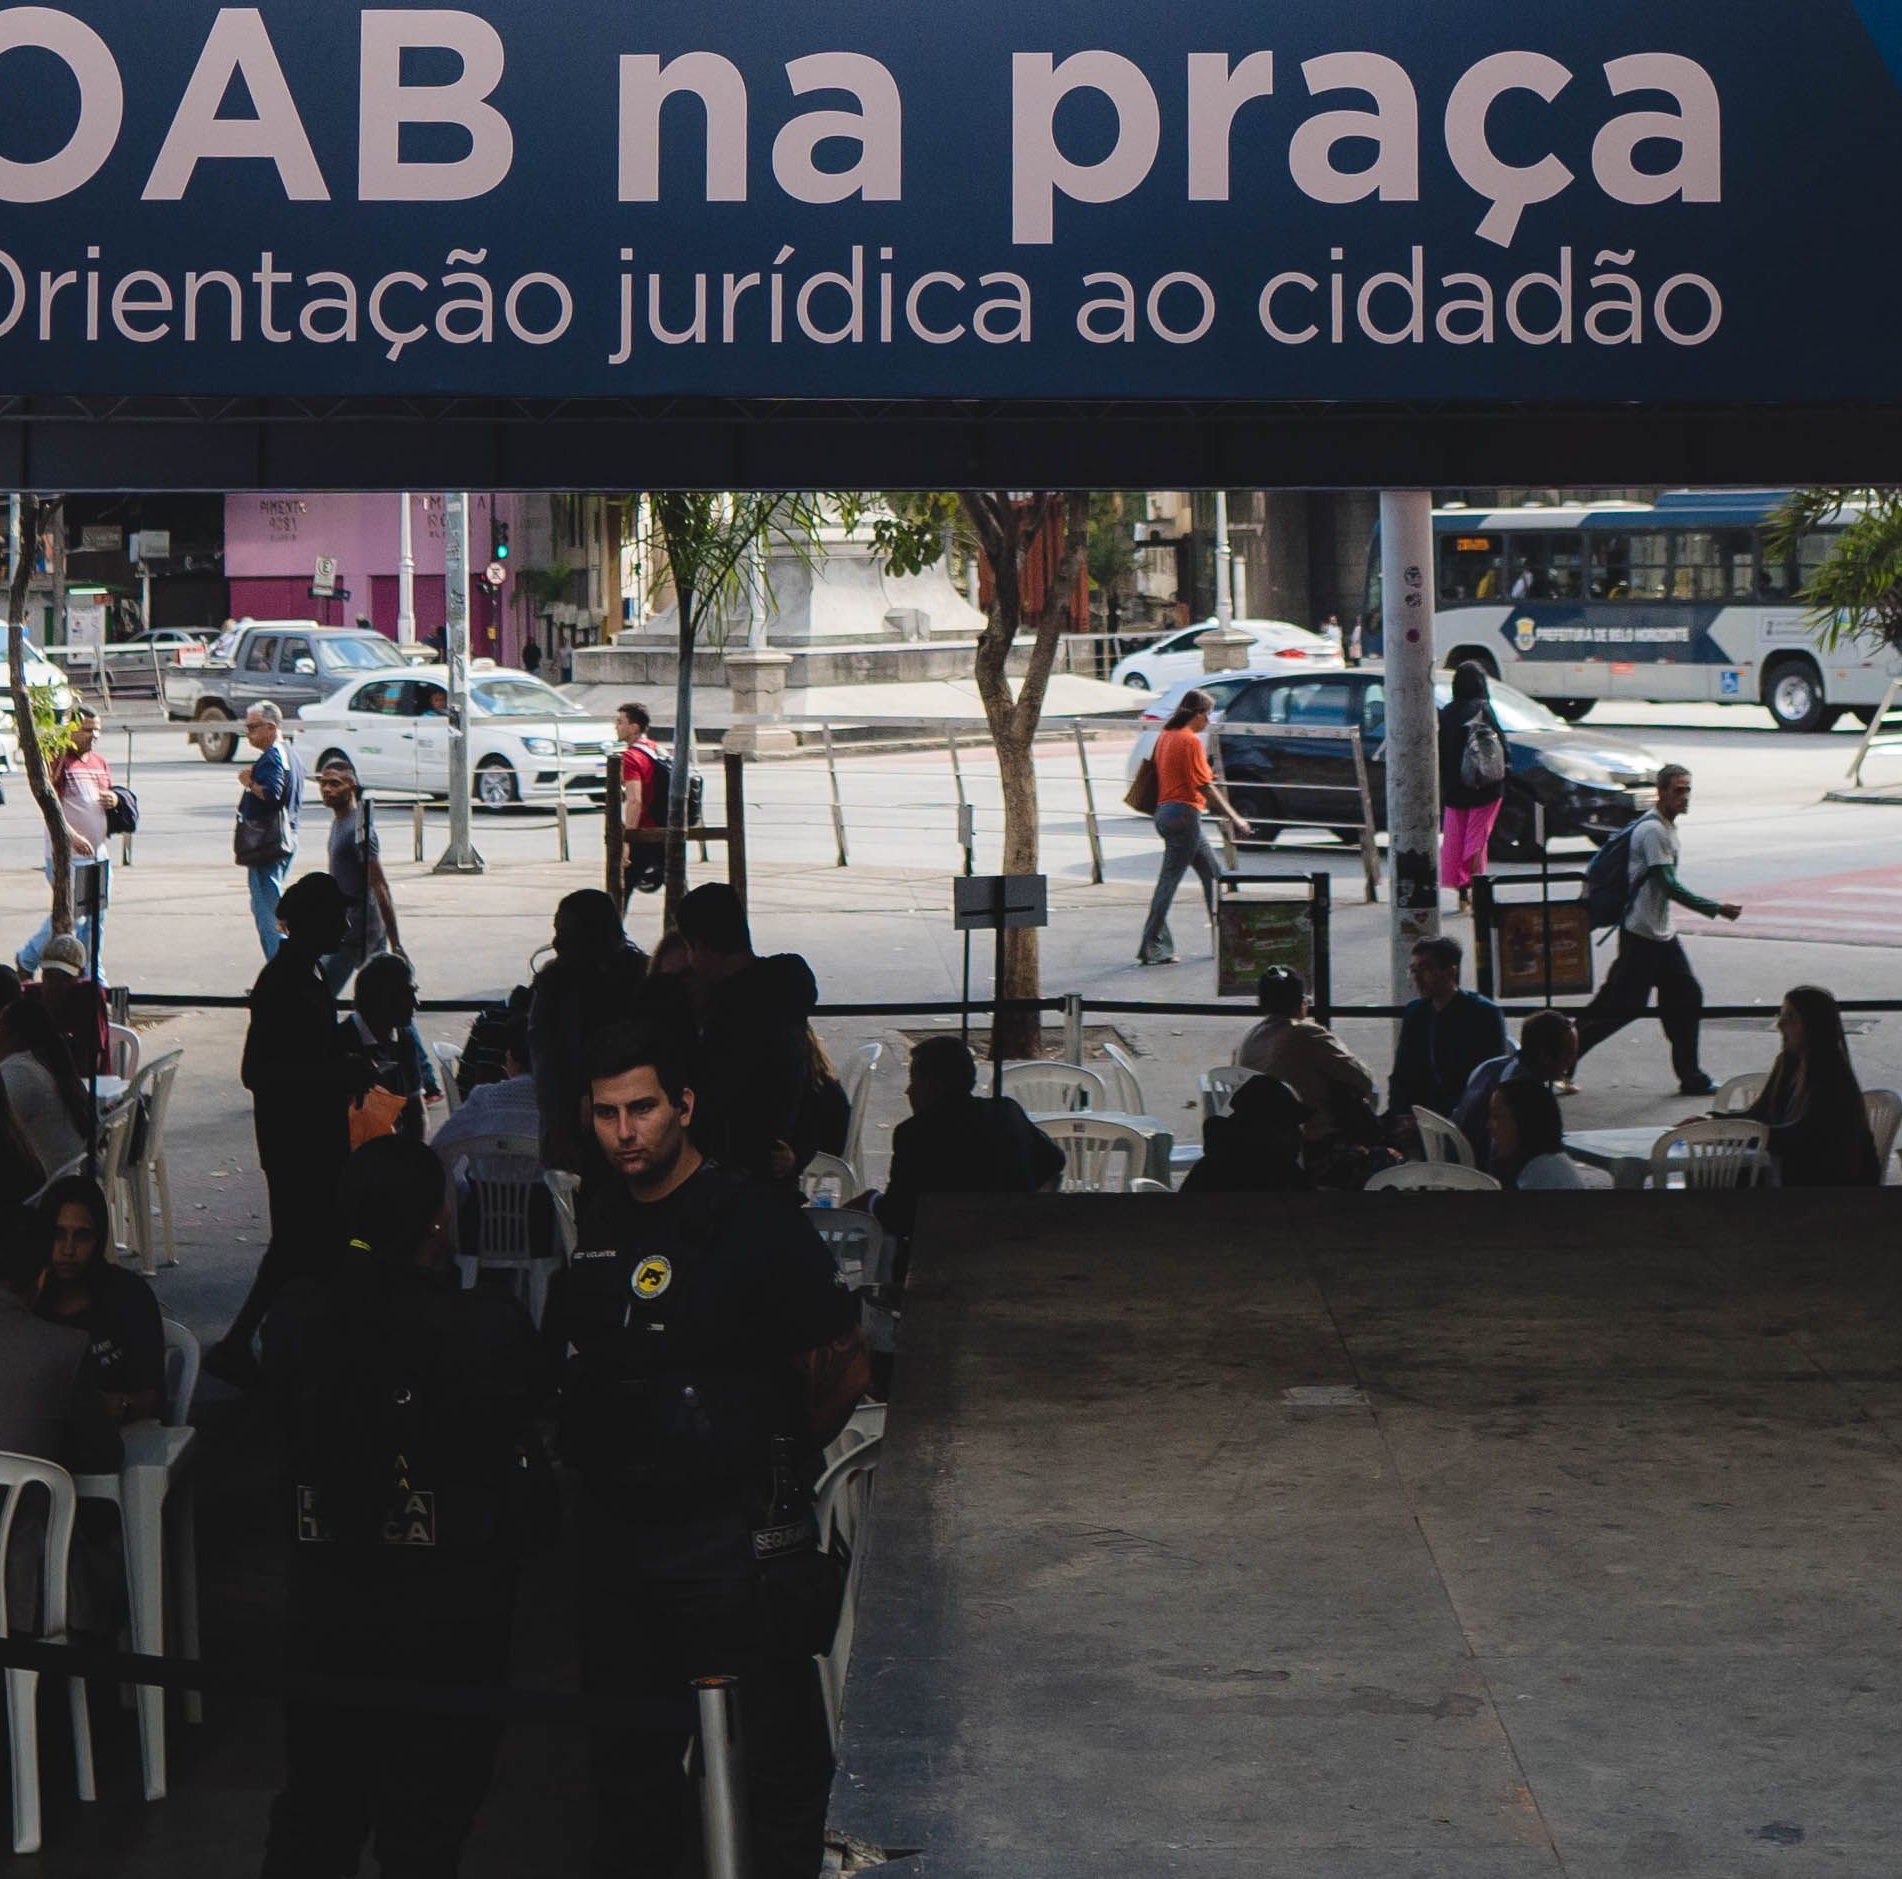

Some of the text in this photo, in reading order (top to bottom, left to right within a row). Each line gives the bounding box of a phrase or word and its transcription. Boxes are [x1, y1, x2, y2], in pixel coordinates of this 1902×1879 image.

[618, 51, 901, 203] na
[1012, 50, 1721, 248] praça
[607, 243, 1030, 364] jurídica
[1076, 271, 1216, 344] ao
[1258, 244, 1722, 346] cidadão
